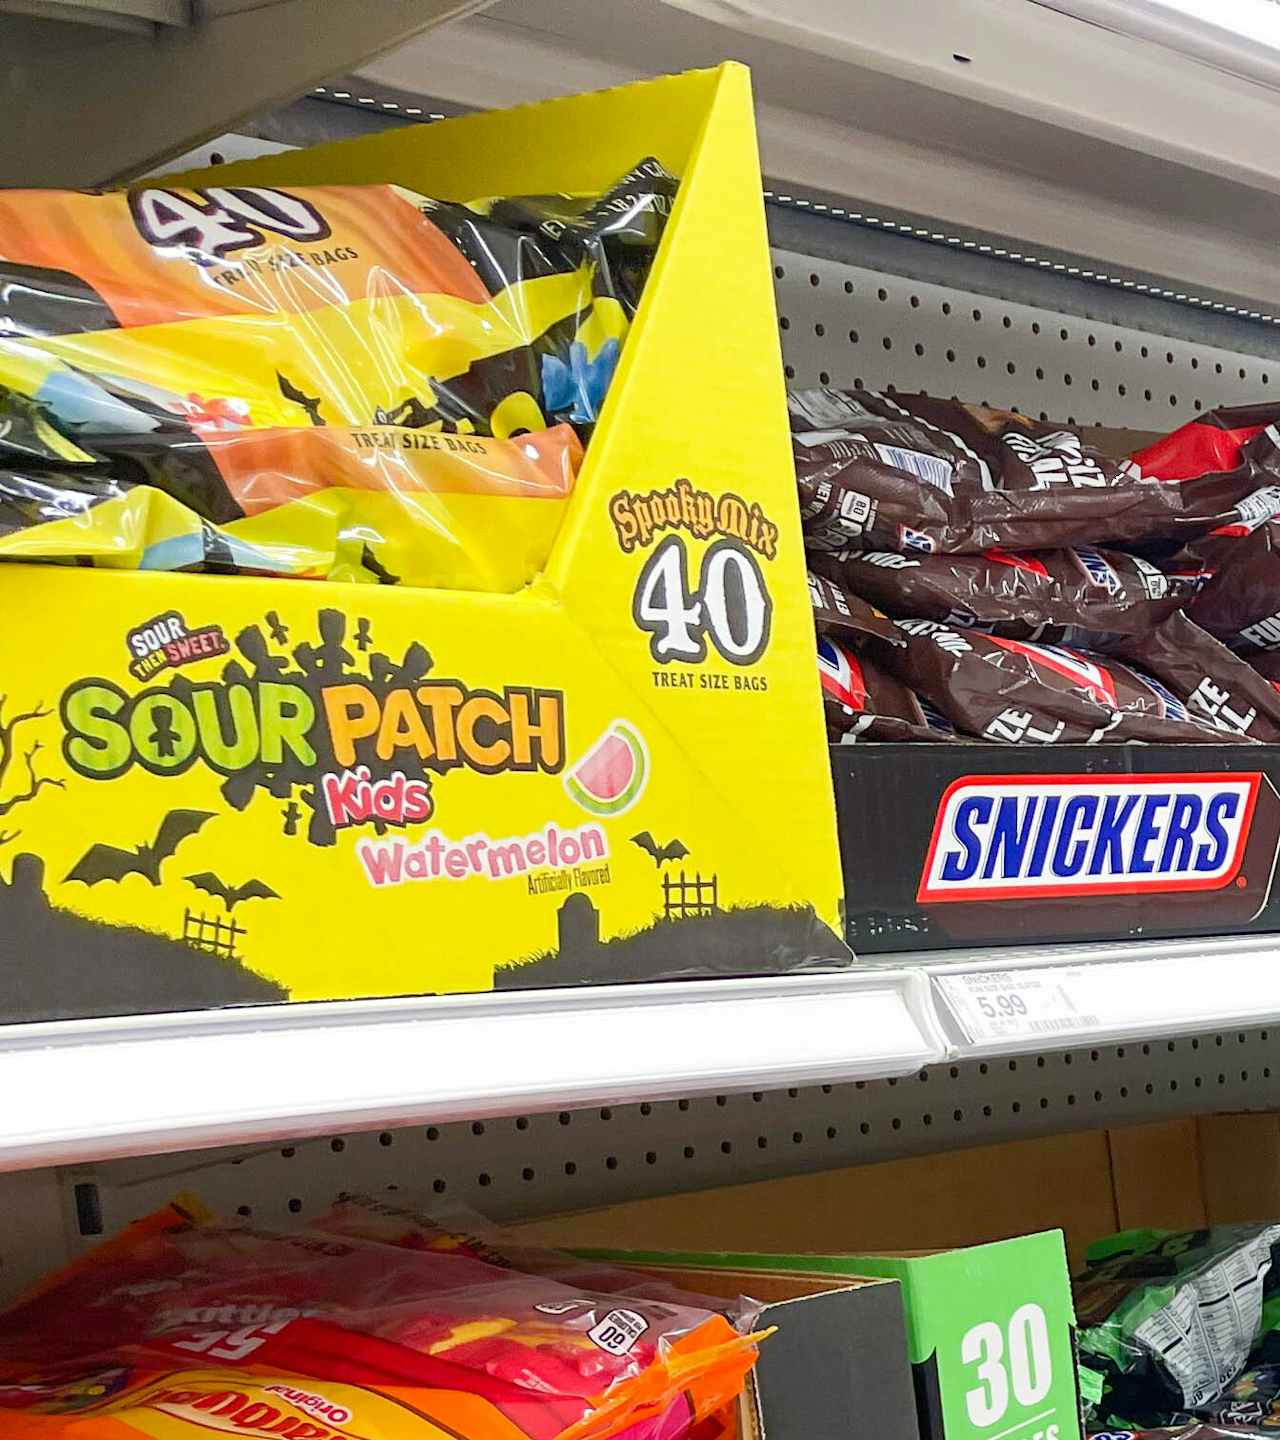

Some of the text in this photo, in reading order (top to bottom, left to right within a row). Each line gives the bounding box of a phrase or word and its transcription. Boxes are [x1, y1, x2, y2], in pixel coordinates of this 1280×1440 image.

[132, 188, 330, 257] 40
[314, 247, 359, 268] BAGS
[402, 433, 440, 450] SIZE
[444, 436, 488, 455] BAGS
[612, 483, 715, 550] Spooky
[716, 497, 777, 558] Mix
[634, 541, 771, 660] 40
[131, 614, 185, 658] SOUR
[134, 648, 168, 679] THEN
[652, 671, 768, 692] TREAT SIZE BAGS
[62, 681, 563, 774] SOUR PATCH
[322, 770, 431, 827] Kids
[360, 827, 606, 885] Watermelon
[939, 791, 1240, 882] SNICKERS
[527, 864, 612, 895] Artificially Flavored
[977, 993, 1028, 1018] 5.99
[960, 1303, 1053, 1428] 30
